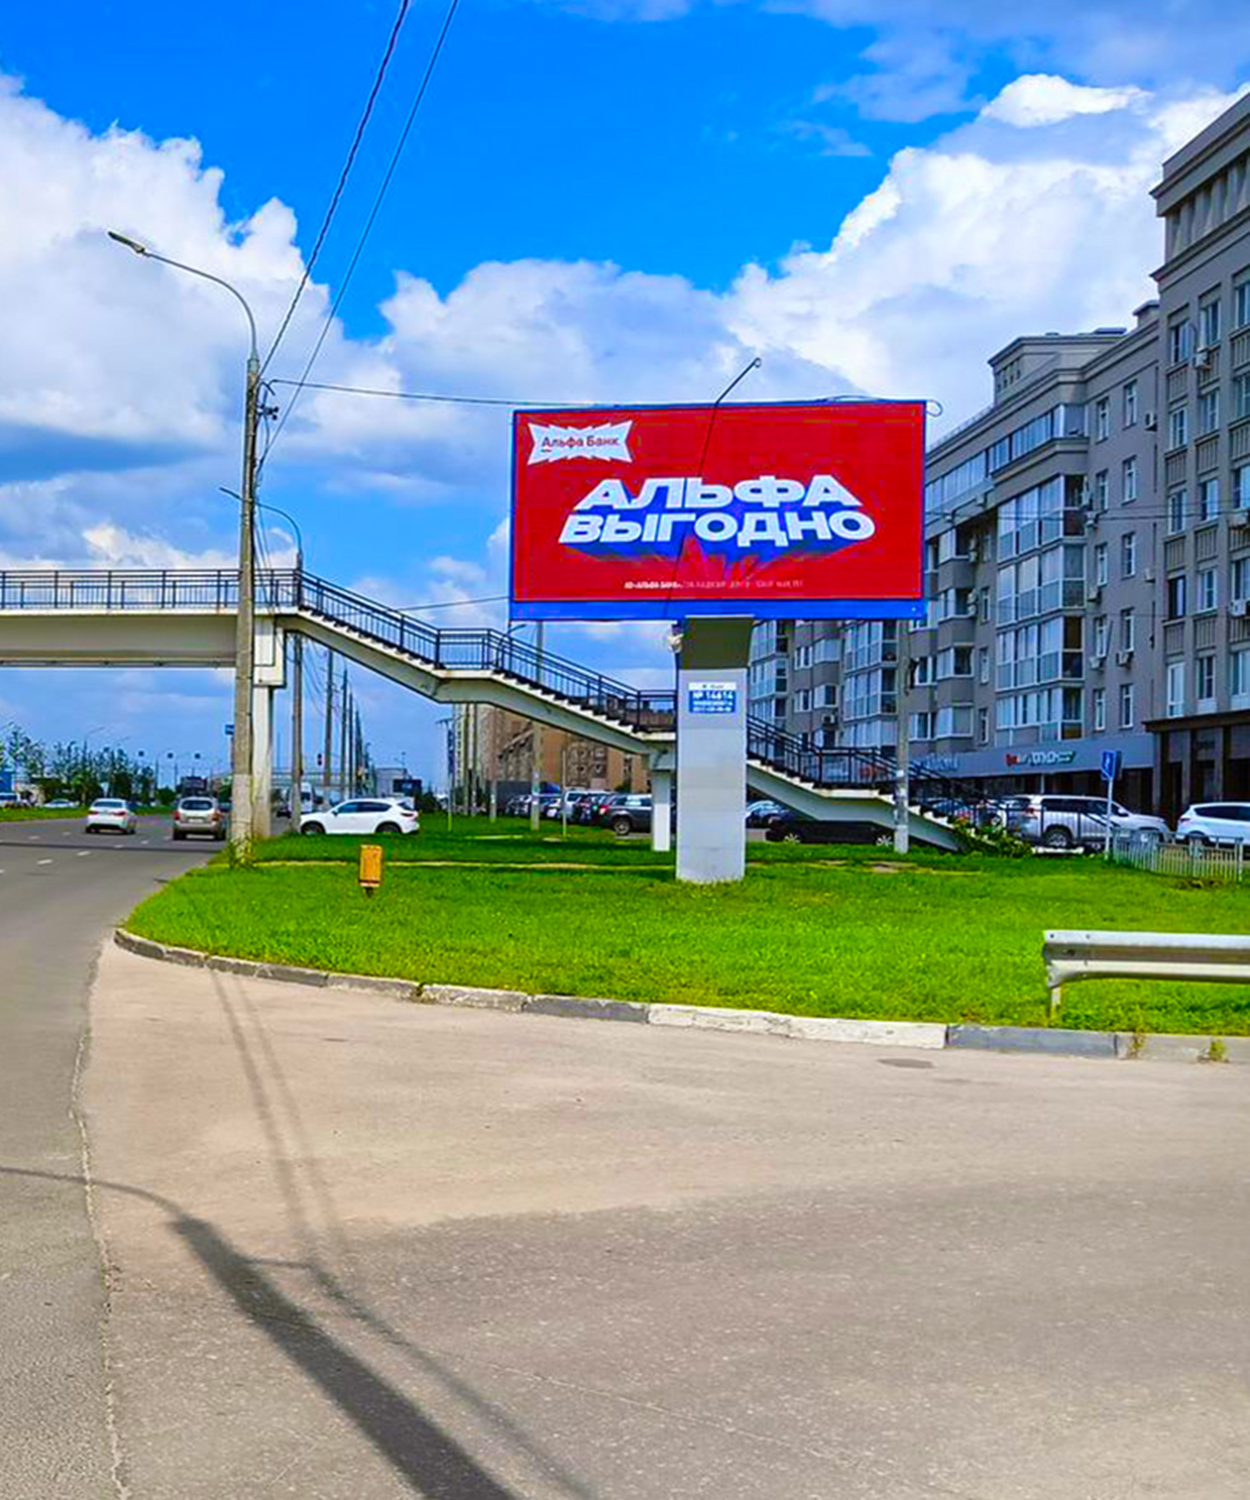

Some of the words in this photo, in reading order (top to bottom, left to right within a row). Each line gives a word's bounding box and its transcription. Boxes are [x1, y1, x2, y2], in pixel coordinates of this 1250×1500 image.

[541, 435, 584, 450] Альфа
[586, 435, 618, 447] Банк
[572, 475, 863, 510] АЛЬФА
[558, 510, 876, 547] ВЫГОДНО
